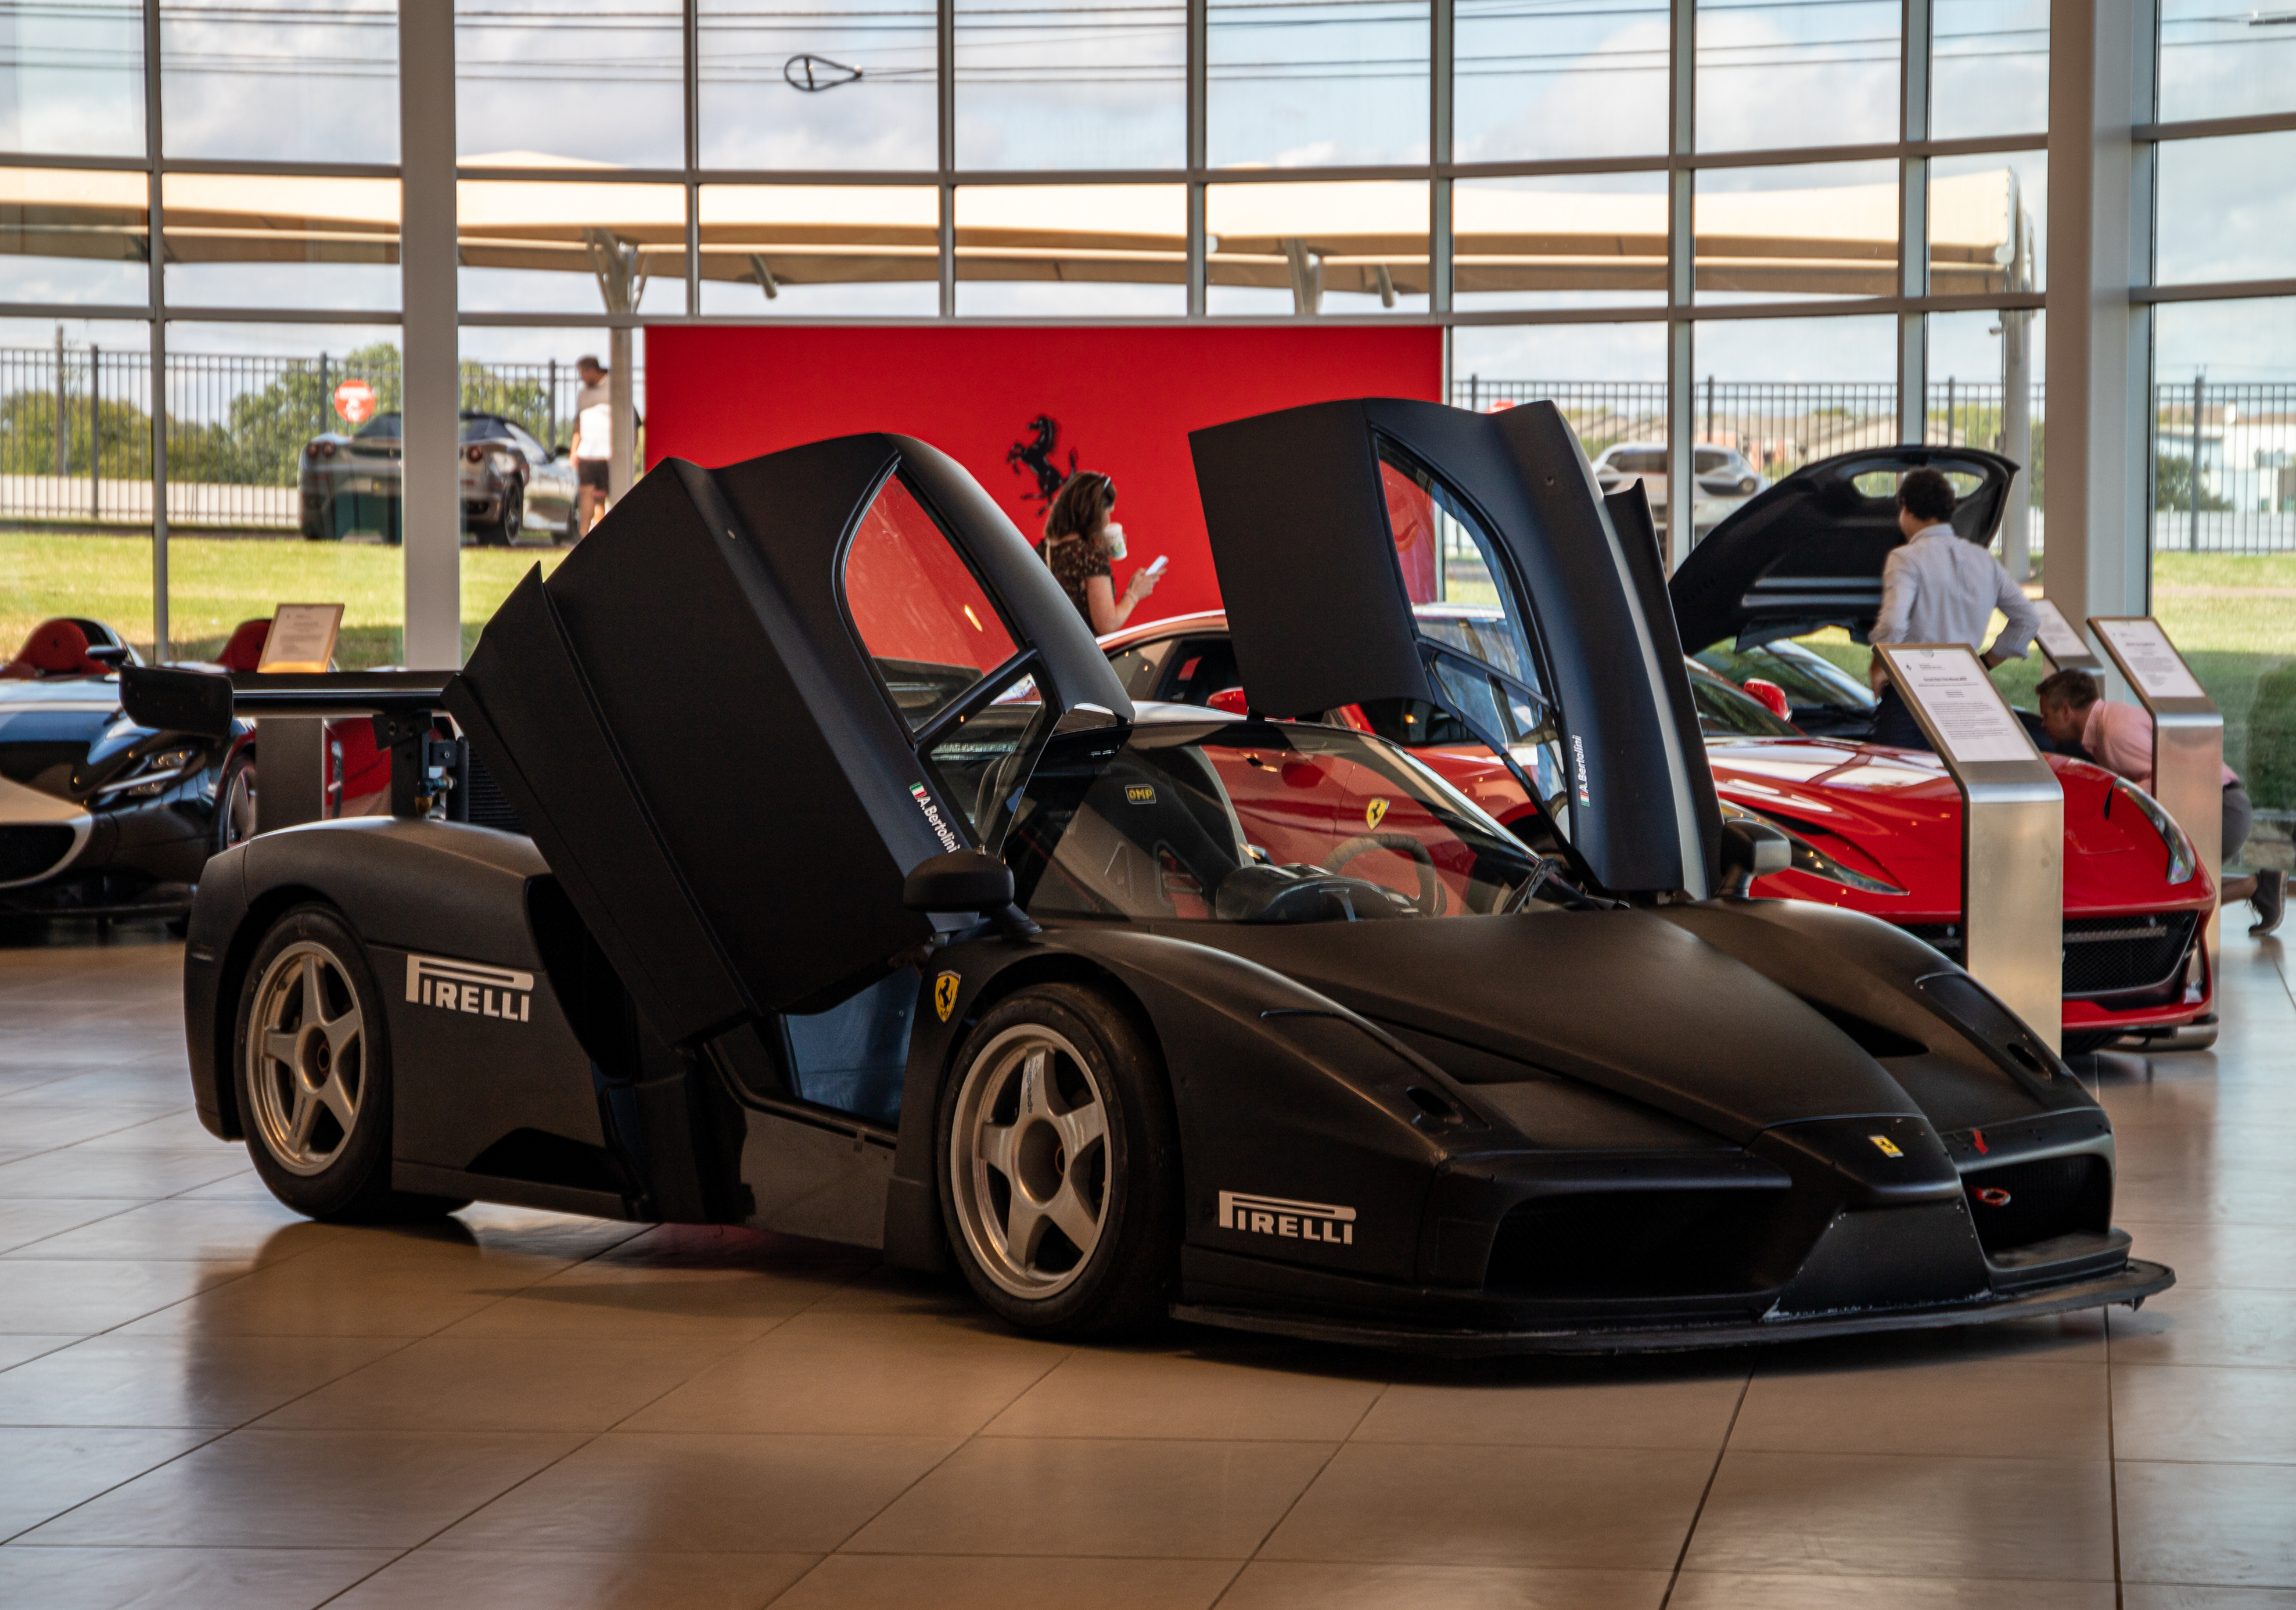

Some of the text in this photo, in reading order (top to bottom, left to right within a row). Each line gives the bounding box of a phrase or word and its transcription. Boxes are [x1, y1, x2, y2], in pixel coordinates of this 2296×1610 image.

[1128, 788, 1152, 801] OMP
[917, 796, 961, 853] A.Bertolini
[406, 954, 534, 1023] PIRELLI
[1219, 1190, 1357, 1245] PIRELLI
